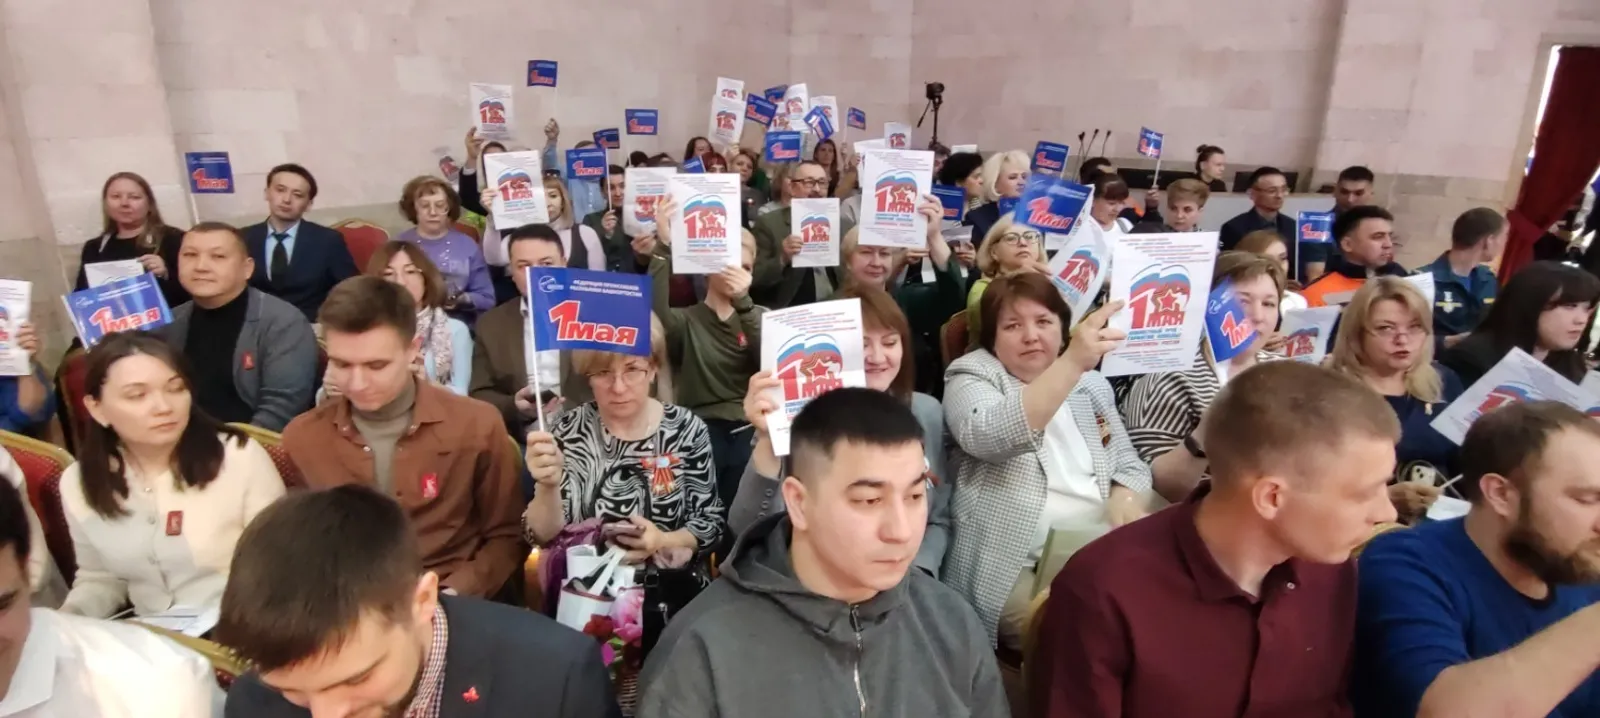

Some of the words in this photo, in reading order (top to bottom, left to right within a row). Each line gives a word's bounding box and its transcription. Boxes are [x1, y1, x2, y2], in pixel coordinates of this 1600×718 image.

[875, 189, 888, 212] 1
[684, 214, 697, 239] 1
[801, 227, 810, 243] 1
[1058, 259, 1081, 281] 1
[1129, 292, 1149, 329] 1
[1146, 311, 1187, 327] МАЯ
[778, 366, 800, 401] 1
